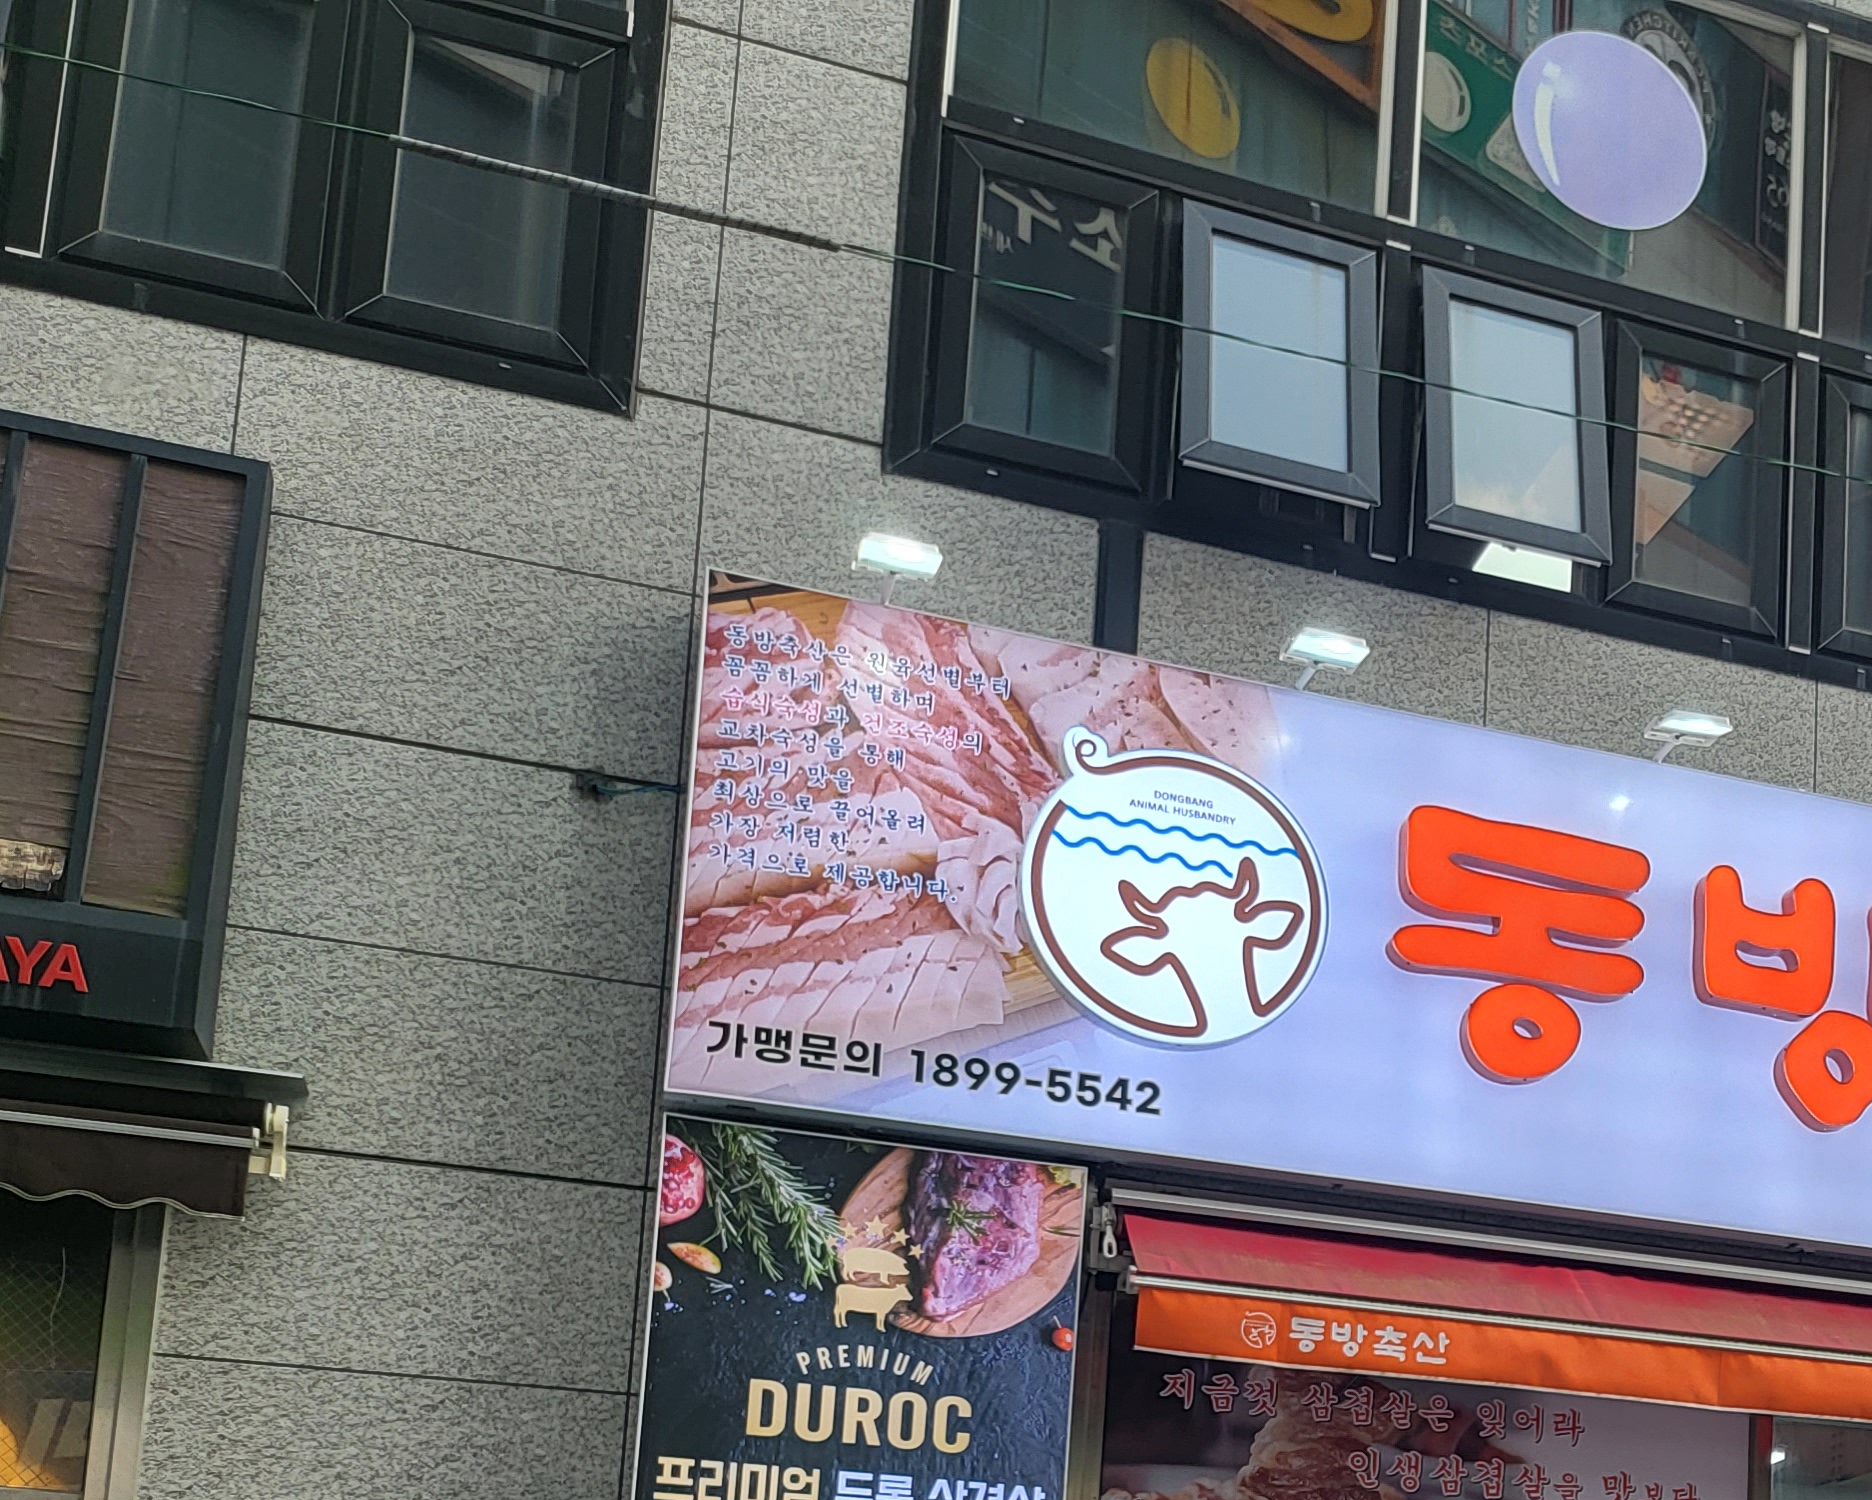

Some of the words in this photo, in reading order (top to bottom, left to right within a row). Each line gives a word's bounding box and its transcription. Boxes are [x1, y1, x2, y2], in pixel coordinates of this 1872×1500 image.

[724, 655, 823, 691] 꼼꼼하게
[839, 678, 934, 714] 선별하며
[726, 625, 851, 661] 동방축산은
[867, 652, 1010, 698] 원육선별부터
[718, 721, 844, 757] 교차숙성을
[860, 745, 906, 769] 통해
[720, 687, 849, 728] 습식숙성과
[861, 712, 983, 755] 건조숙성의
[716, 751, 789, 779] 고기의
[807, 765, 853, 791] 맛을
[714, 781, 814, 814] 최상으로
[830, 801, 926, 833] 끌어올려
[1129, 799, 1169, 815] ANIMAL
[1172, 805, 1236, 826] HUSBANDRY
[1153, 789, 1214, 809] DONGBANG
[711, 813, 760, 838] 가장
[778, 824, 849, 852] 저렴한
[710, 844, 811, 877] 가격으로
[824, 864, 957, 902] 제공합니다.
[0, 934, 88, 992] YA
[706, 1019, 883, 1077] 가맹문의
[910, 1049, 1162, 1116] 1899-5542
[796, 1344, 934, 1387] PREMIUM
[1289, 1316, 1451, 1365] 동방축산
[744, 1377, 973, 1455] DUROC
[1159, 1368, 1278, 1415] 지금껏
[1303, 1384, 1456, 1432] 삼겹살은
[1475, 1400, 1586, 1446] 잊어라
